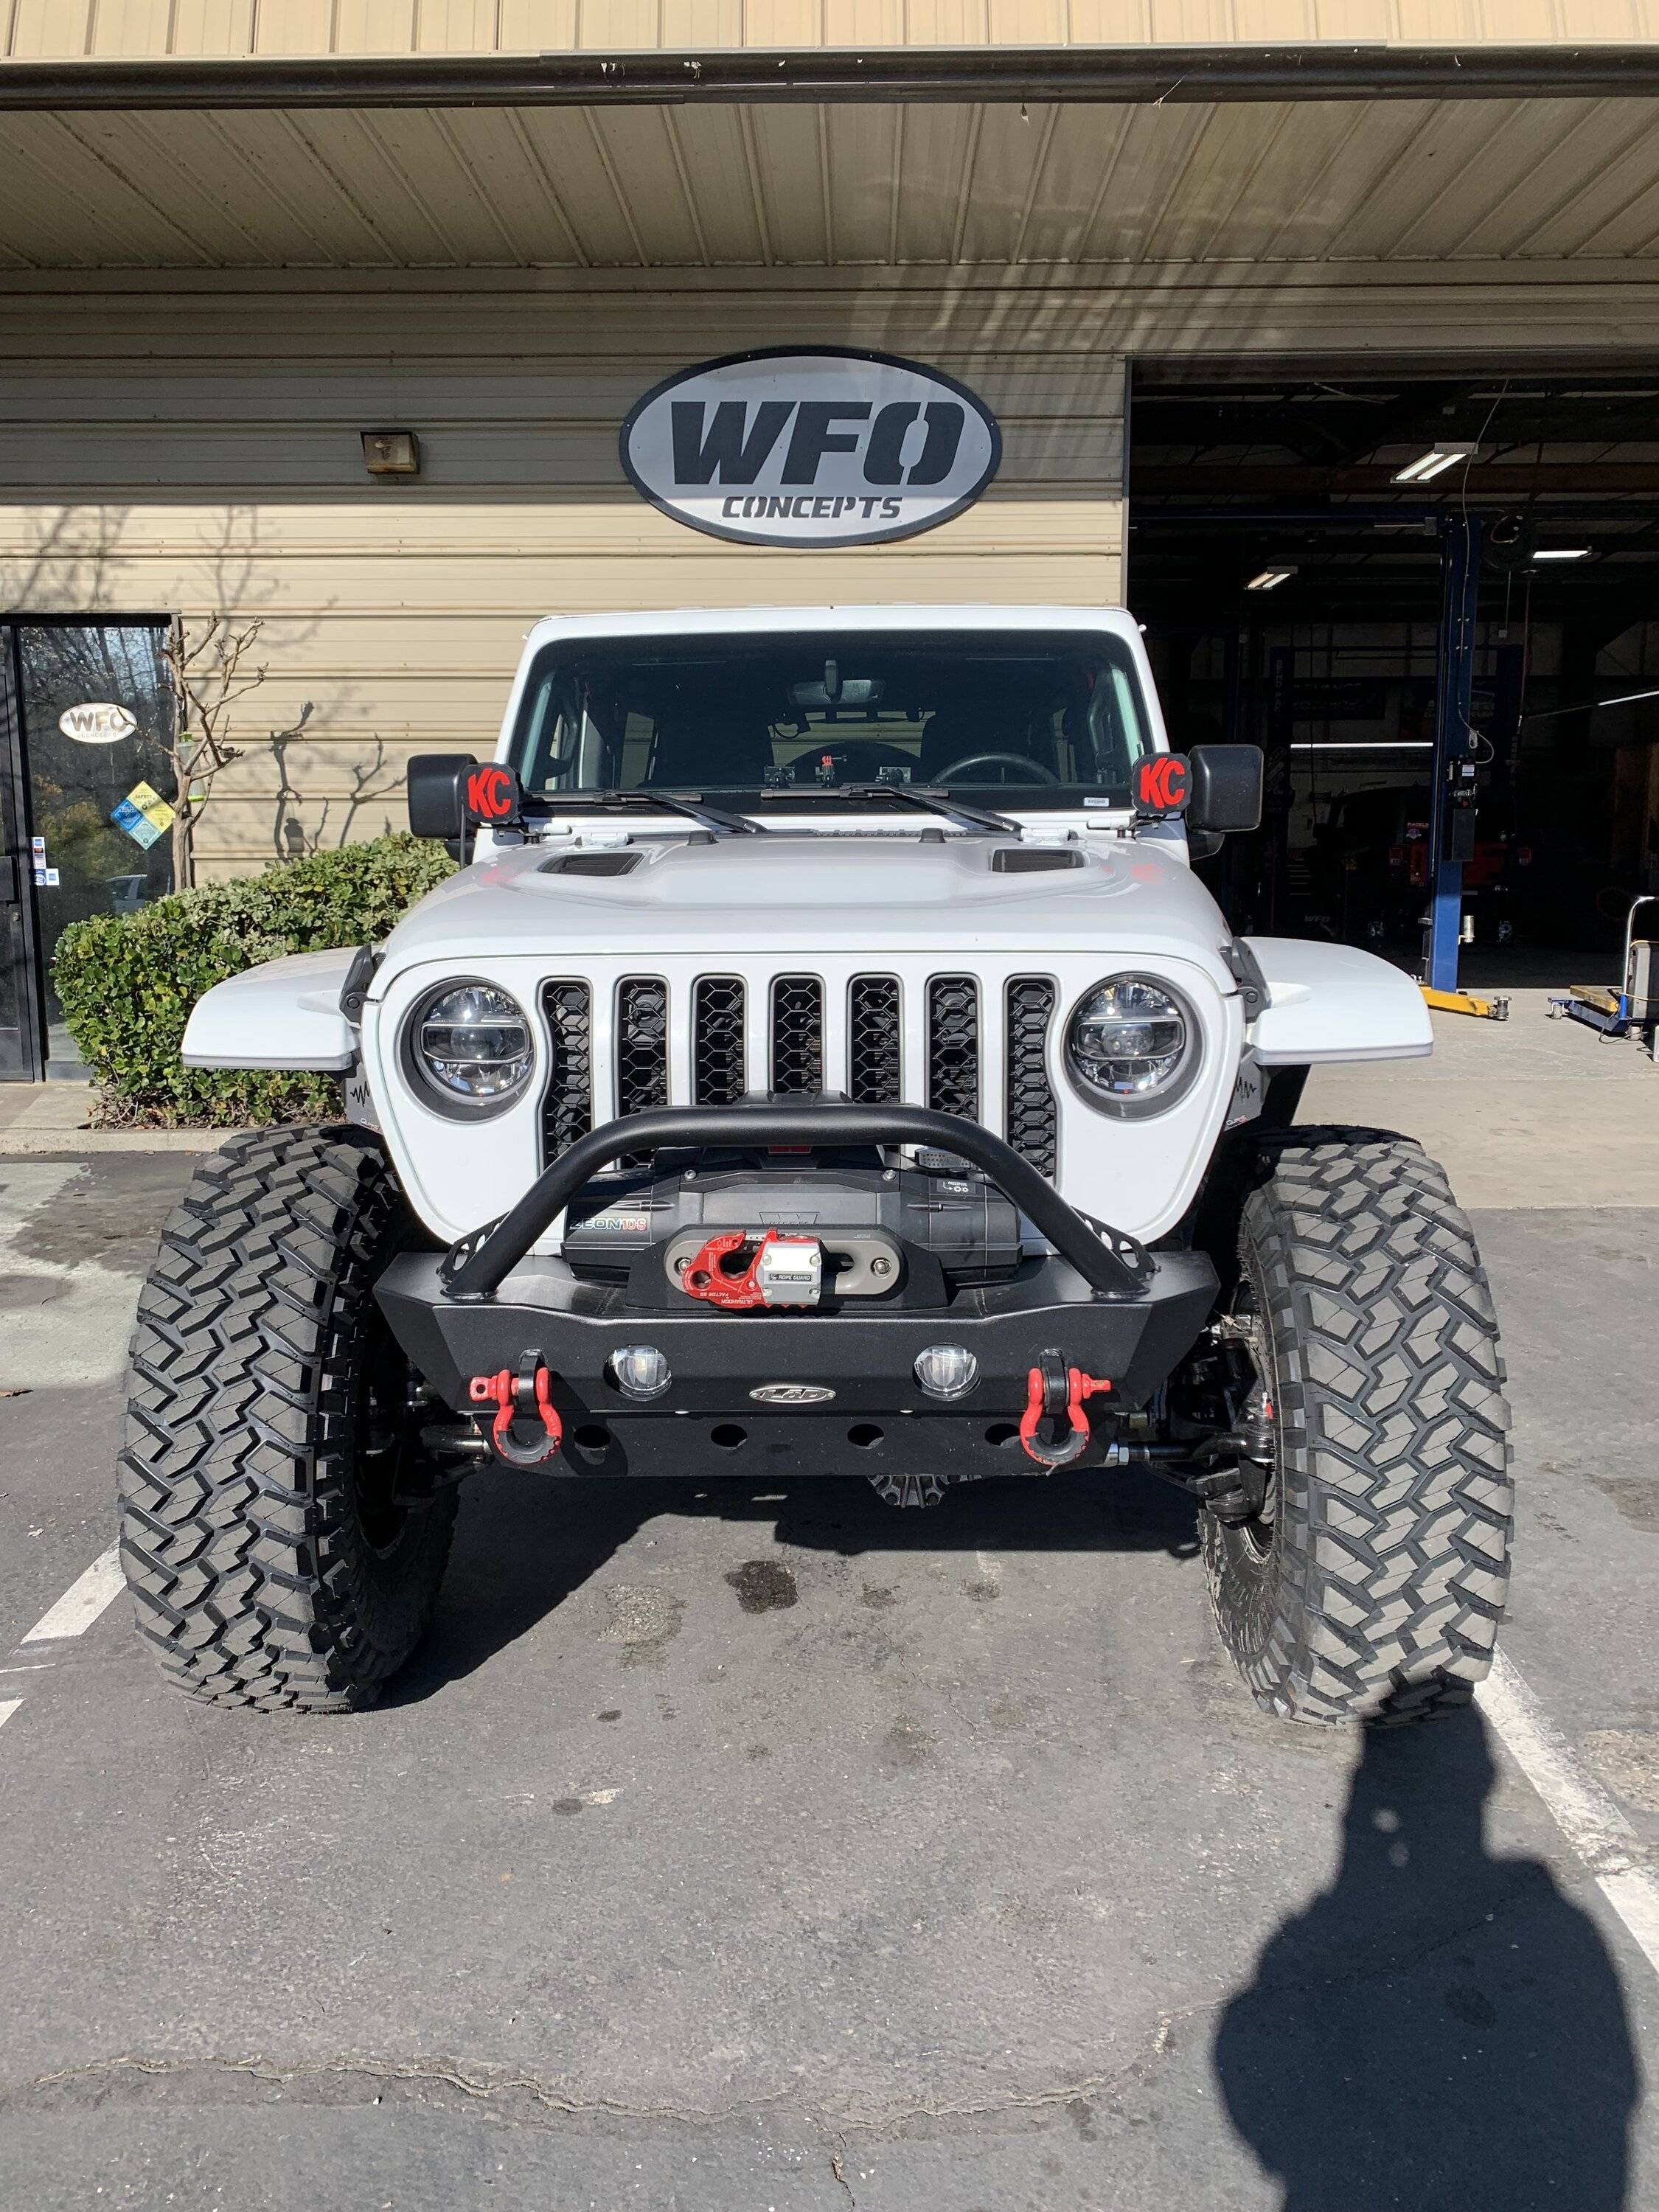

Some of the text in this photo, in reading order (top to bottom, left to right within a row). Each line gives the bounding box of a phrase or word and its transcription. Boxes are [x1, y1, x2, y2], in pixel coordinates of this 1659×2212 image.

[671, 400, 966, 485] WFO
[722, 495, 902, 518] CONCEPTS
[70, 712, 128, 731] WFO
[468, 767, 511, 818] KC
[1141, 757, 1185, 809] KC
